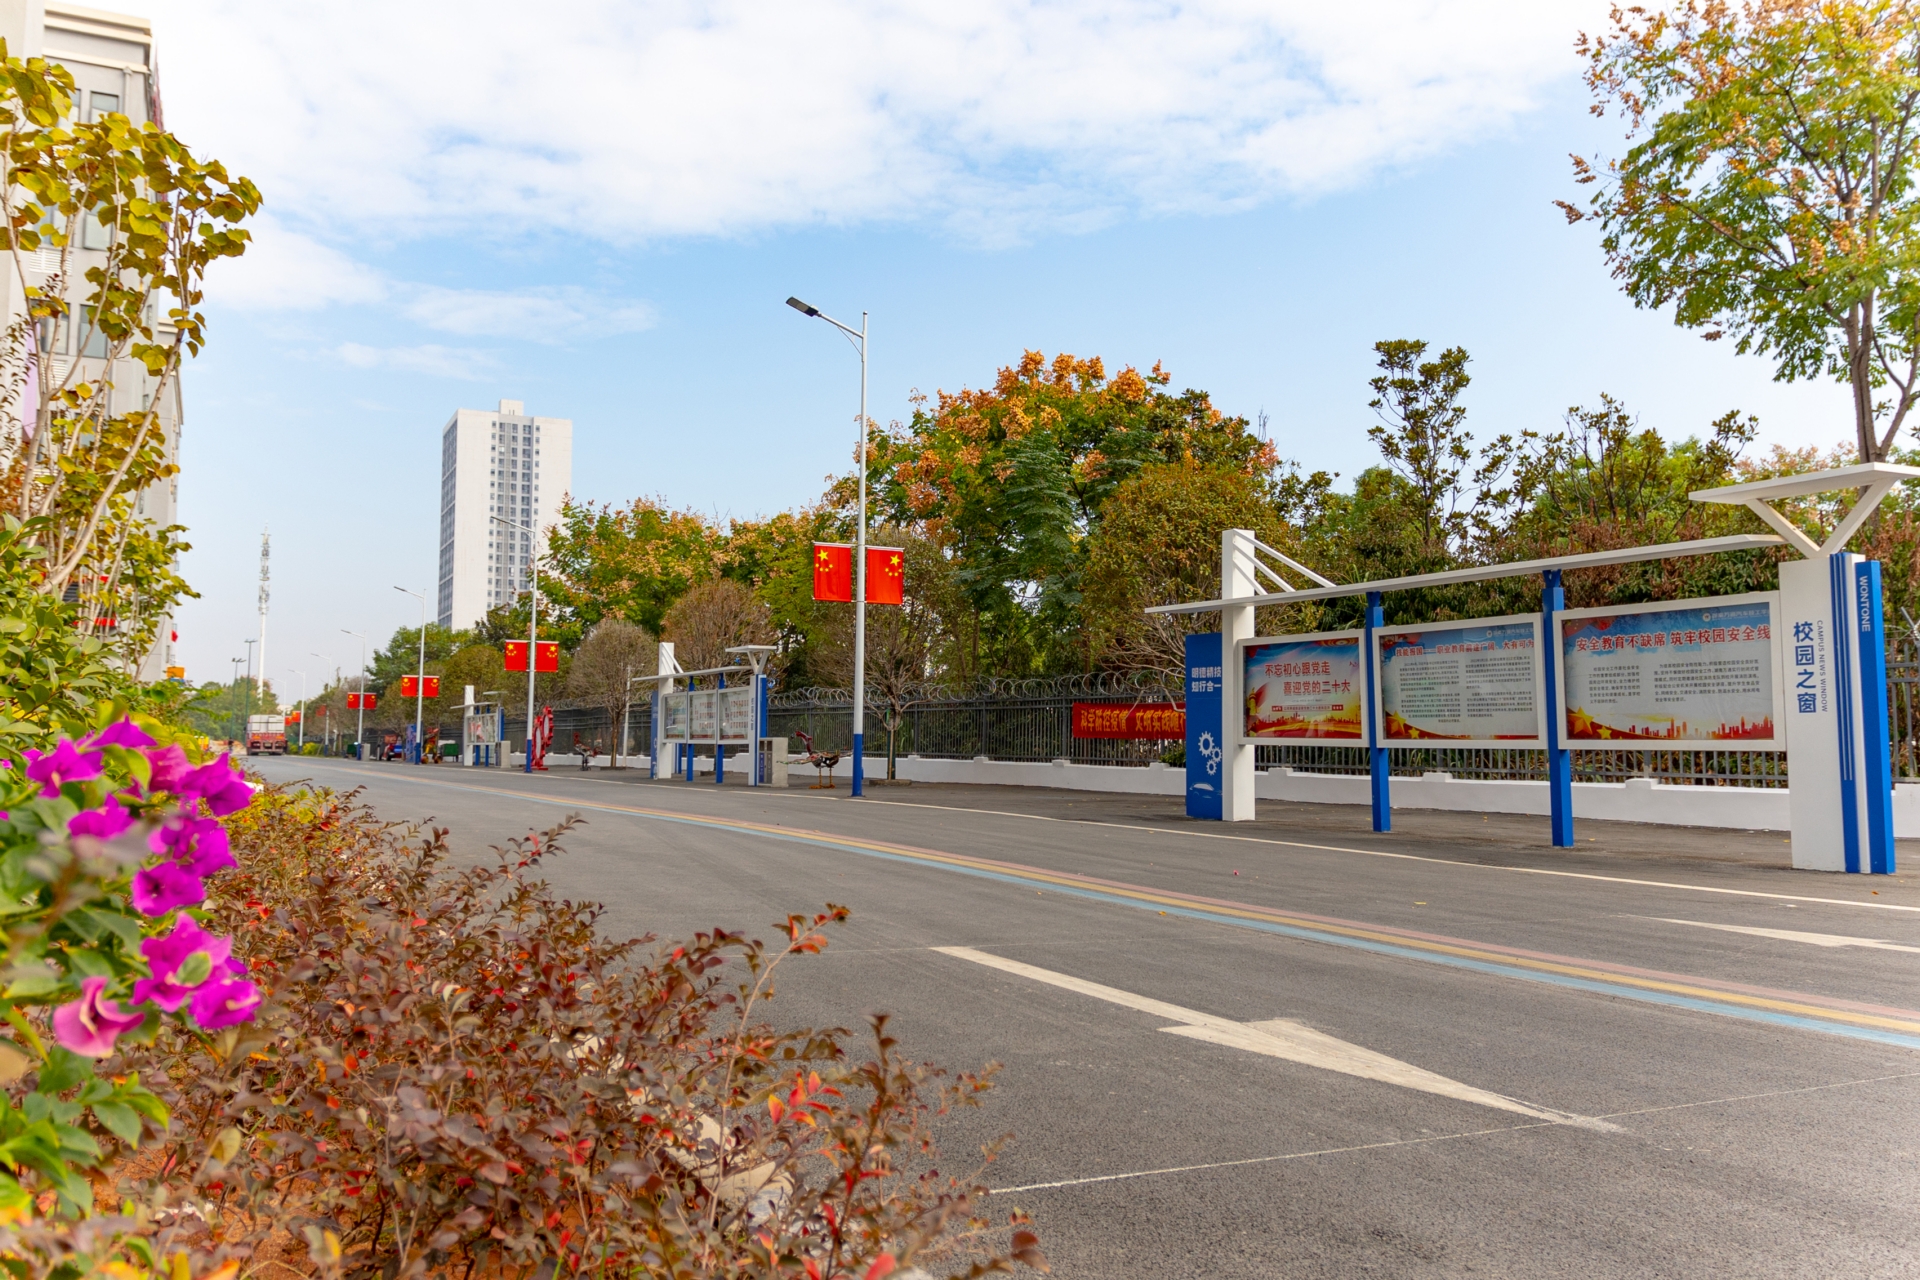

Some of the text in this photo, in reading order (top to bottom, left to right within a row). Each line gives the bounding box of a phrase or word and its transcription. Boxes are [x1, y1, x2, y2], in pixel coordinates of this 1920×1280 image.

[1859, 575, 1871, 632] WONTONE
[1576, 625, 1770, 651] 安全教育不缺席 筑牢校园安全线
[1191, 666, 1221, 678] 明德精技
[1265, 661, 1331, 676] 不忘初心跟党走
[1793, 621, 1817, 713] 校园之窗
[1817, 620, 1828, 712] CAMPUS NEWS WINDOW
[1191, 681, 1221, 692] 知行合一
[1283, 679, 1350, 695] 喜迎党的二十大
[1081, 709, 1130, 732] 科学防控疫情
